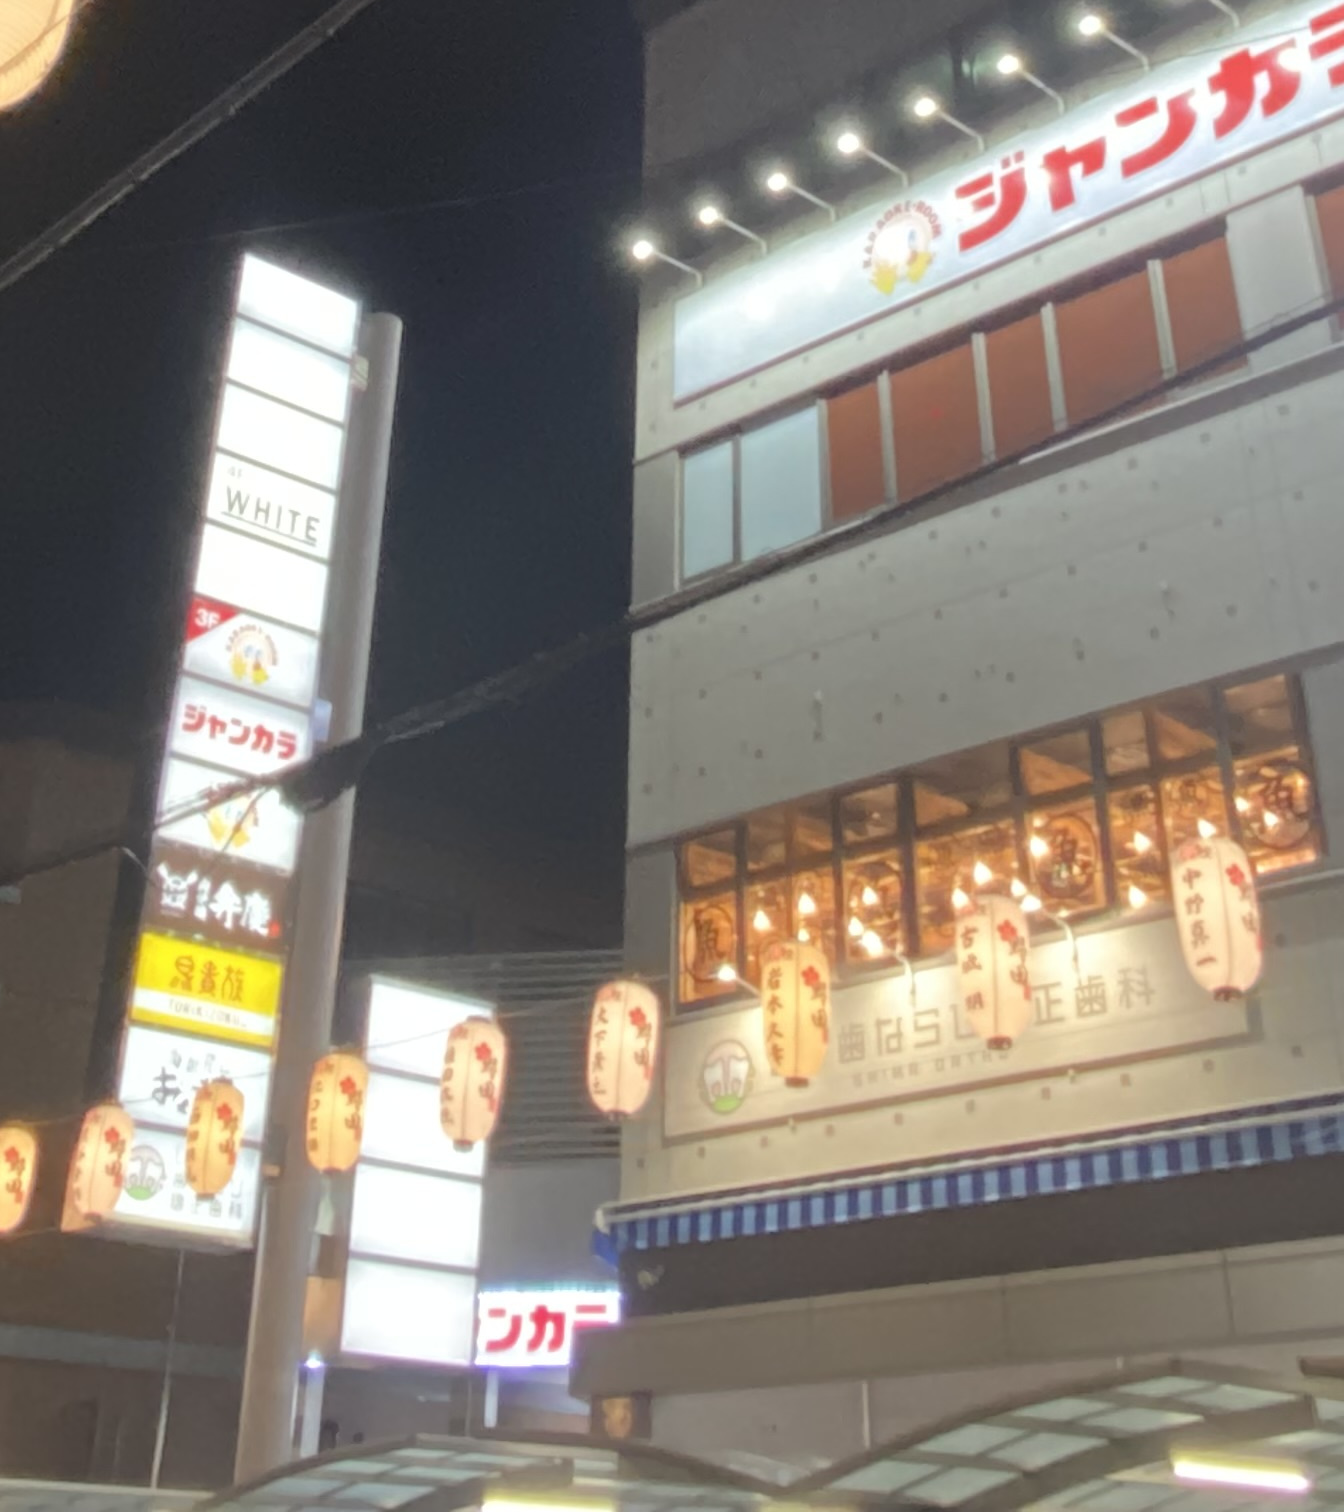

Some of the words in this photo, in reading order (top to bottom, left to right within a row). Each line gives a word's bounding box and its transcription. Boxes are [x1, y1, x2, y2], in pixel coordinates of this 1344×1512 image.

[225, 484, 321, 544] WHITE
[194, 607, 221, 629] 3F
[181, 703, 297, 760] ジャンカラ
[168, 954, 246, 1003] 鳥貴族
